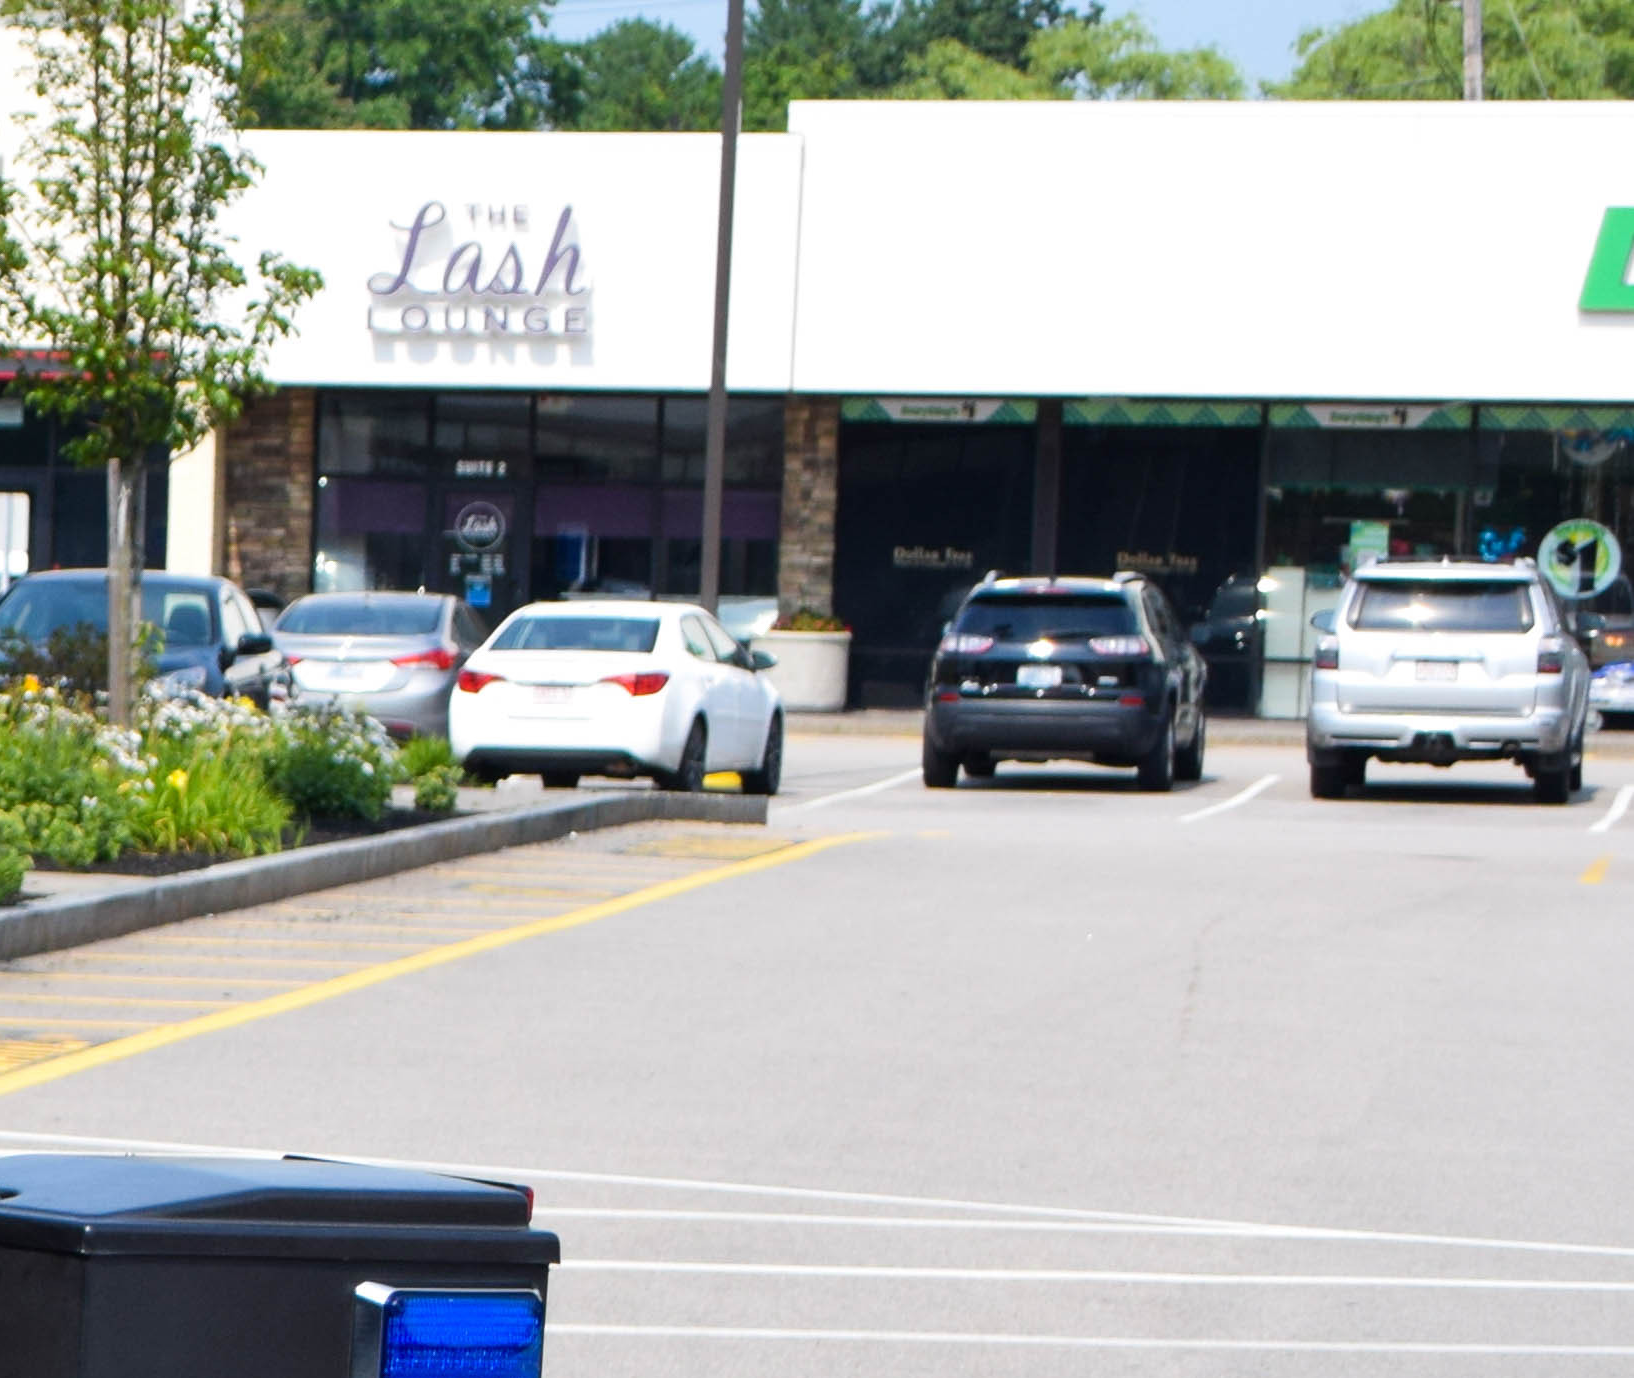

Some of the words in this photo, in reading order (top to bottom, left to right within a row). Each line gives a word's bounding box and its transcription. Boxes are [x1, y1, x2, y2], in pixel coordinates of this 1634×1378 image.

[467, 203, 529, 226] THE
[367, 199, 587, 297] Lash
[368, 304, 589, 333] LOUNGE
[455, 459, 494, 476] SUITE
[497, 460, 507, 476] 2
